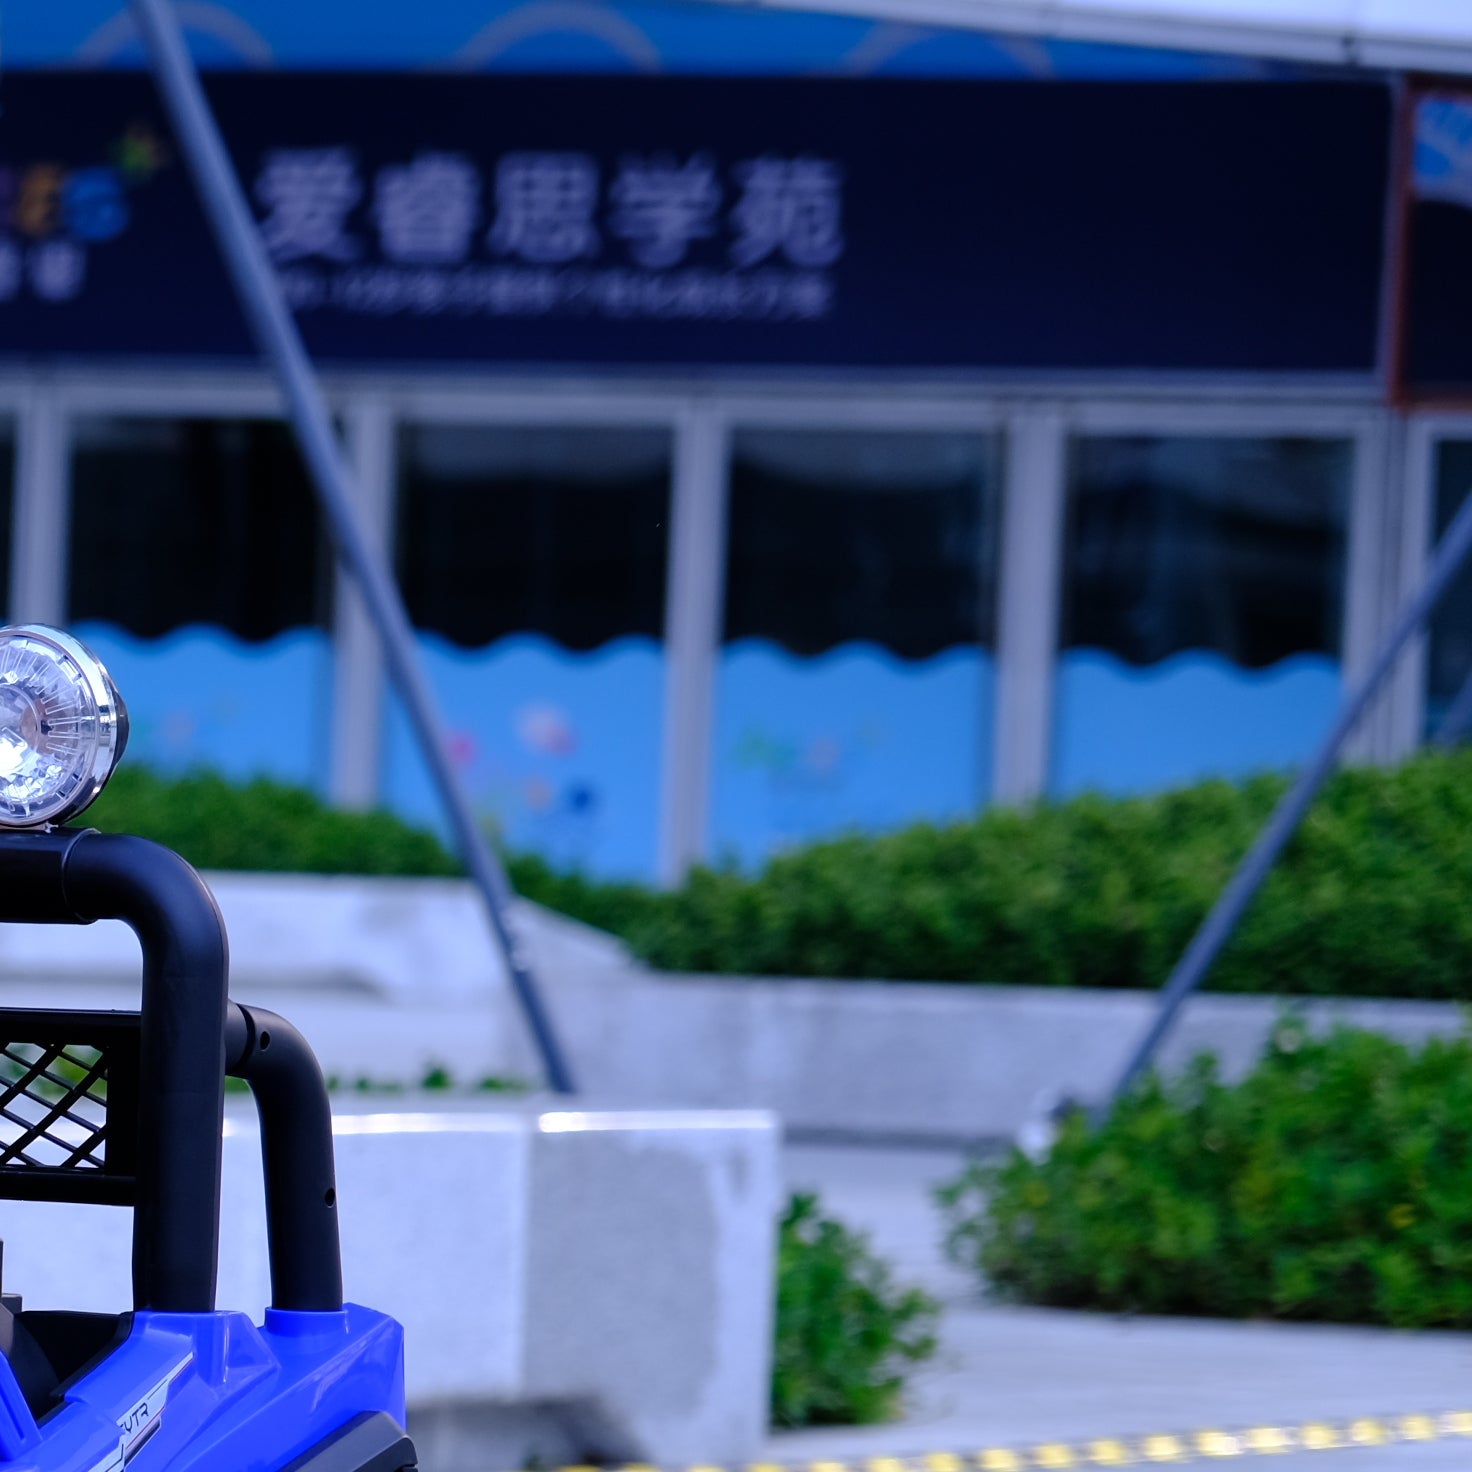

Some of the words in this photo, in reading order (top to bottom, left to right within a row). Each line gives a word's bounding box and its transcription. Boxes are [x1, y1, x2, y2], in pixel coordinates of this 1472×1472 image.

[259, 147, 845, 266] 爱睿思学苑
